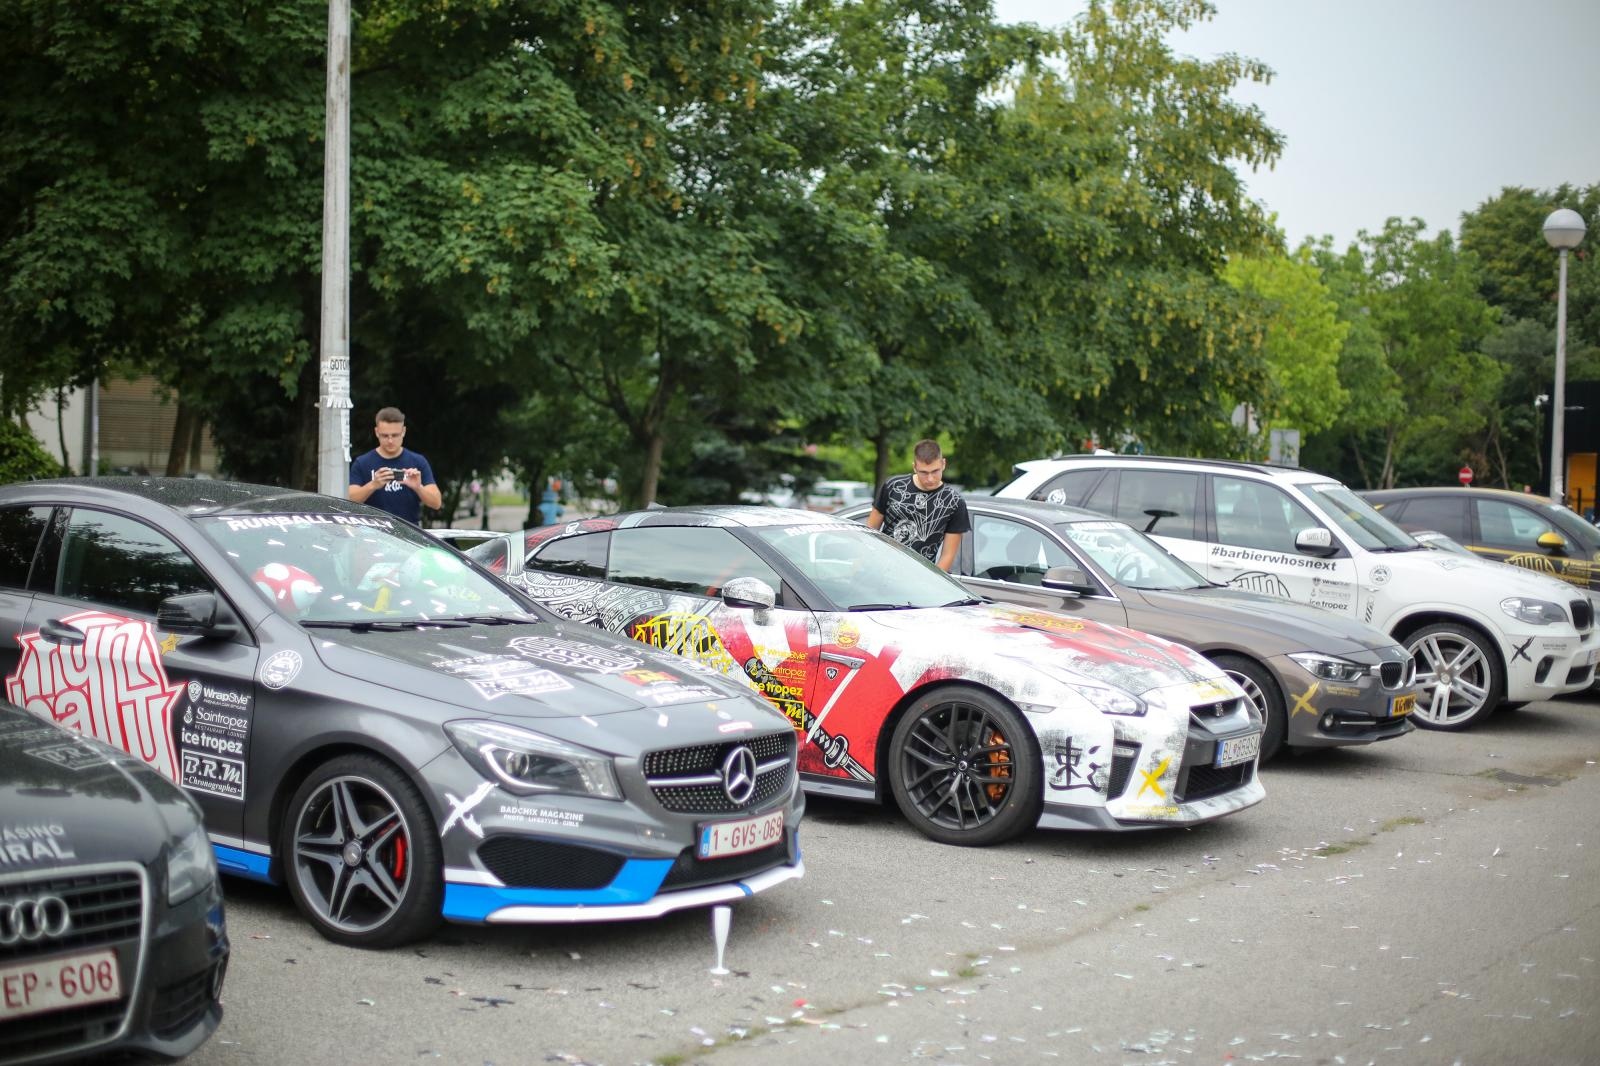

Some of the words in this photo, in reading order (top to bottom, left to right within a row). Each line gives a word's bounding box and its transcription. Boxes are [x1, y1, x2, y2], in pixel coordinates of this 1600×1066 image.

[226, 515, 333, 531] RUNBALL
[333, 515, 394, 529] RALLY
[1211, 546, 1336, 571] #barbierwhosnext
[1322, 600, 1348, 610] tropez
[766, 682, 803, 696] tropez
[196, 707, 248, 729] Saintropez
[181, 727, 200, 745] ice
[201, 732, 243, 754] tropez
[500, 805, 538, 816] BADCHIX
[540, 809, 584, 822] MAGAZINE
[0, 824, 65, 841] ASINO
